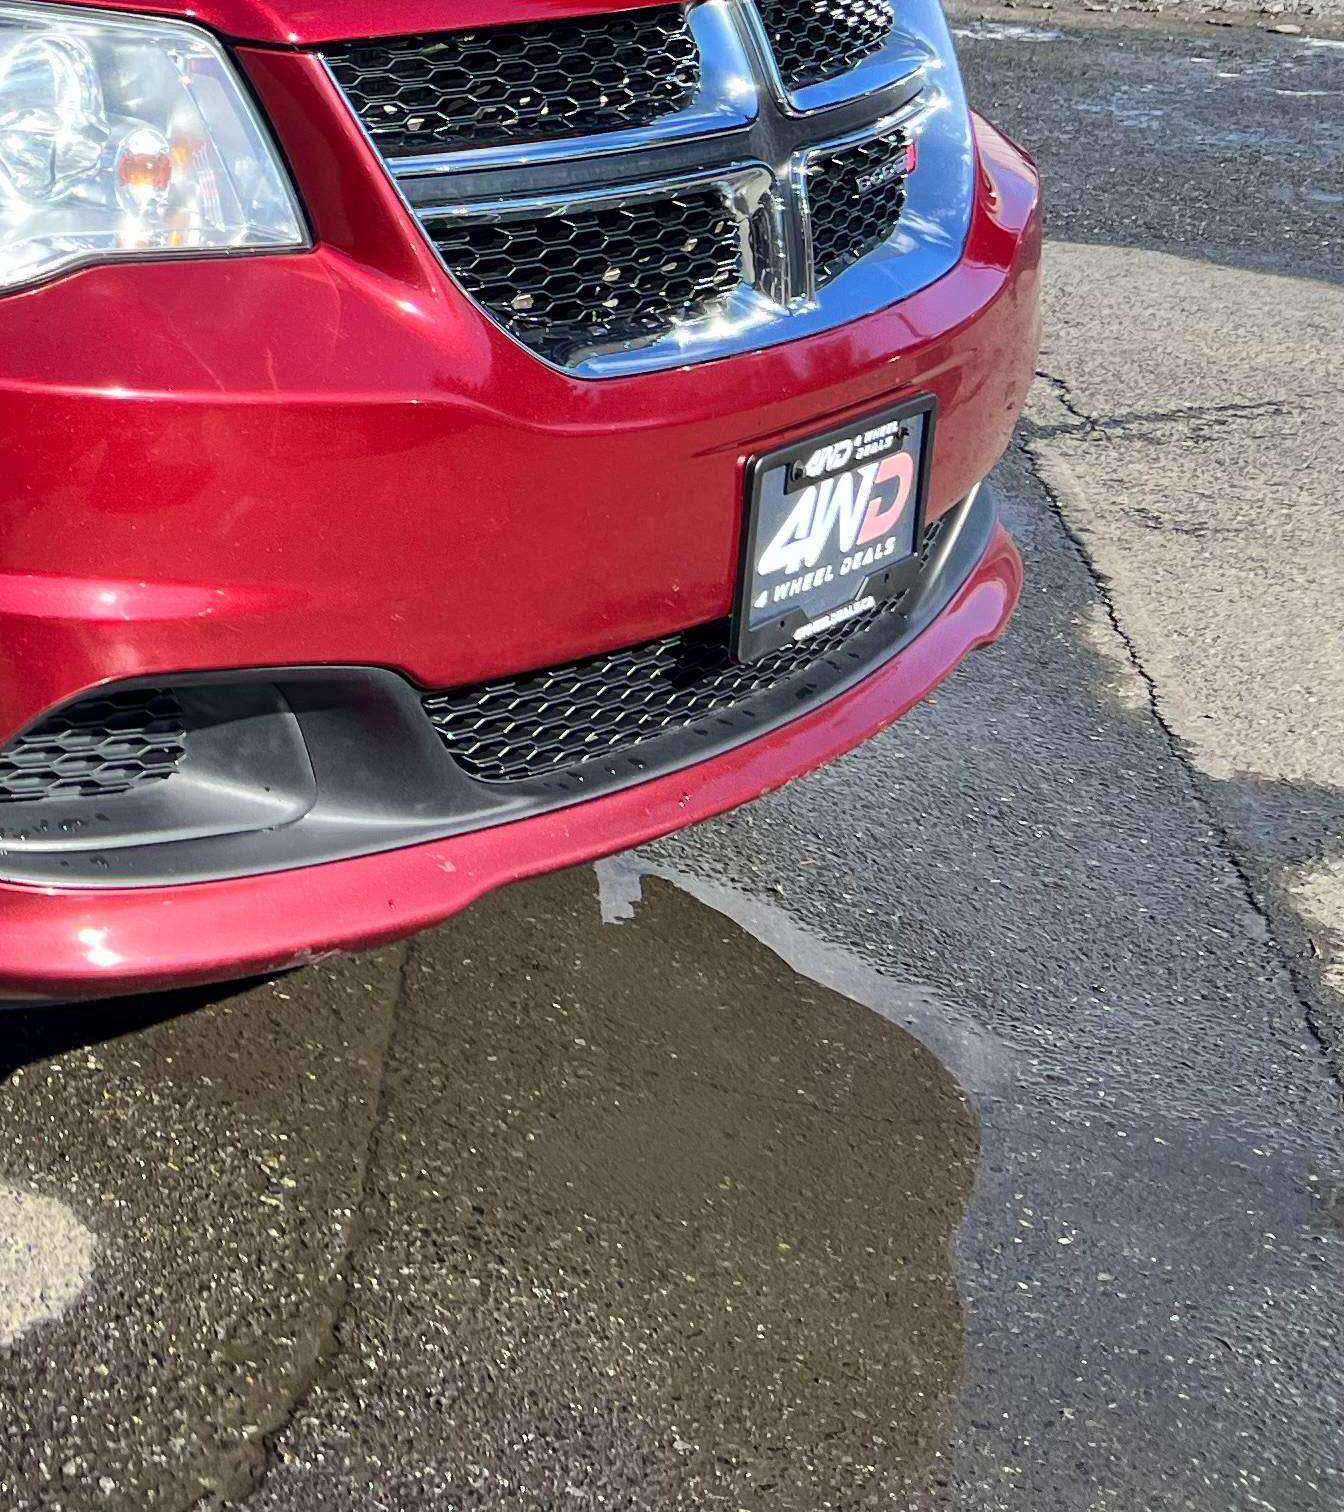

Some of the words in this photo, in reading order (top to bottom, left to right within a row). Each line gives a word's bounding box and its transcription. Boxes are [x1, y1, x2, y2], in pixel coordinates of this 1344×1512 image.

[757, 451, 915, 576] 4WD
[753, 590, 769, 609] 4
[773, 564, 835, 603] WHEEL
[839, 536, 897, 576] DEALS
